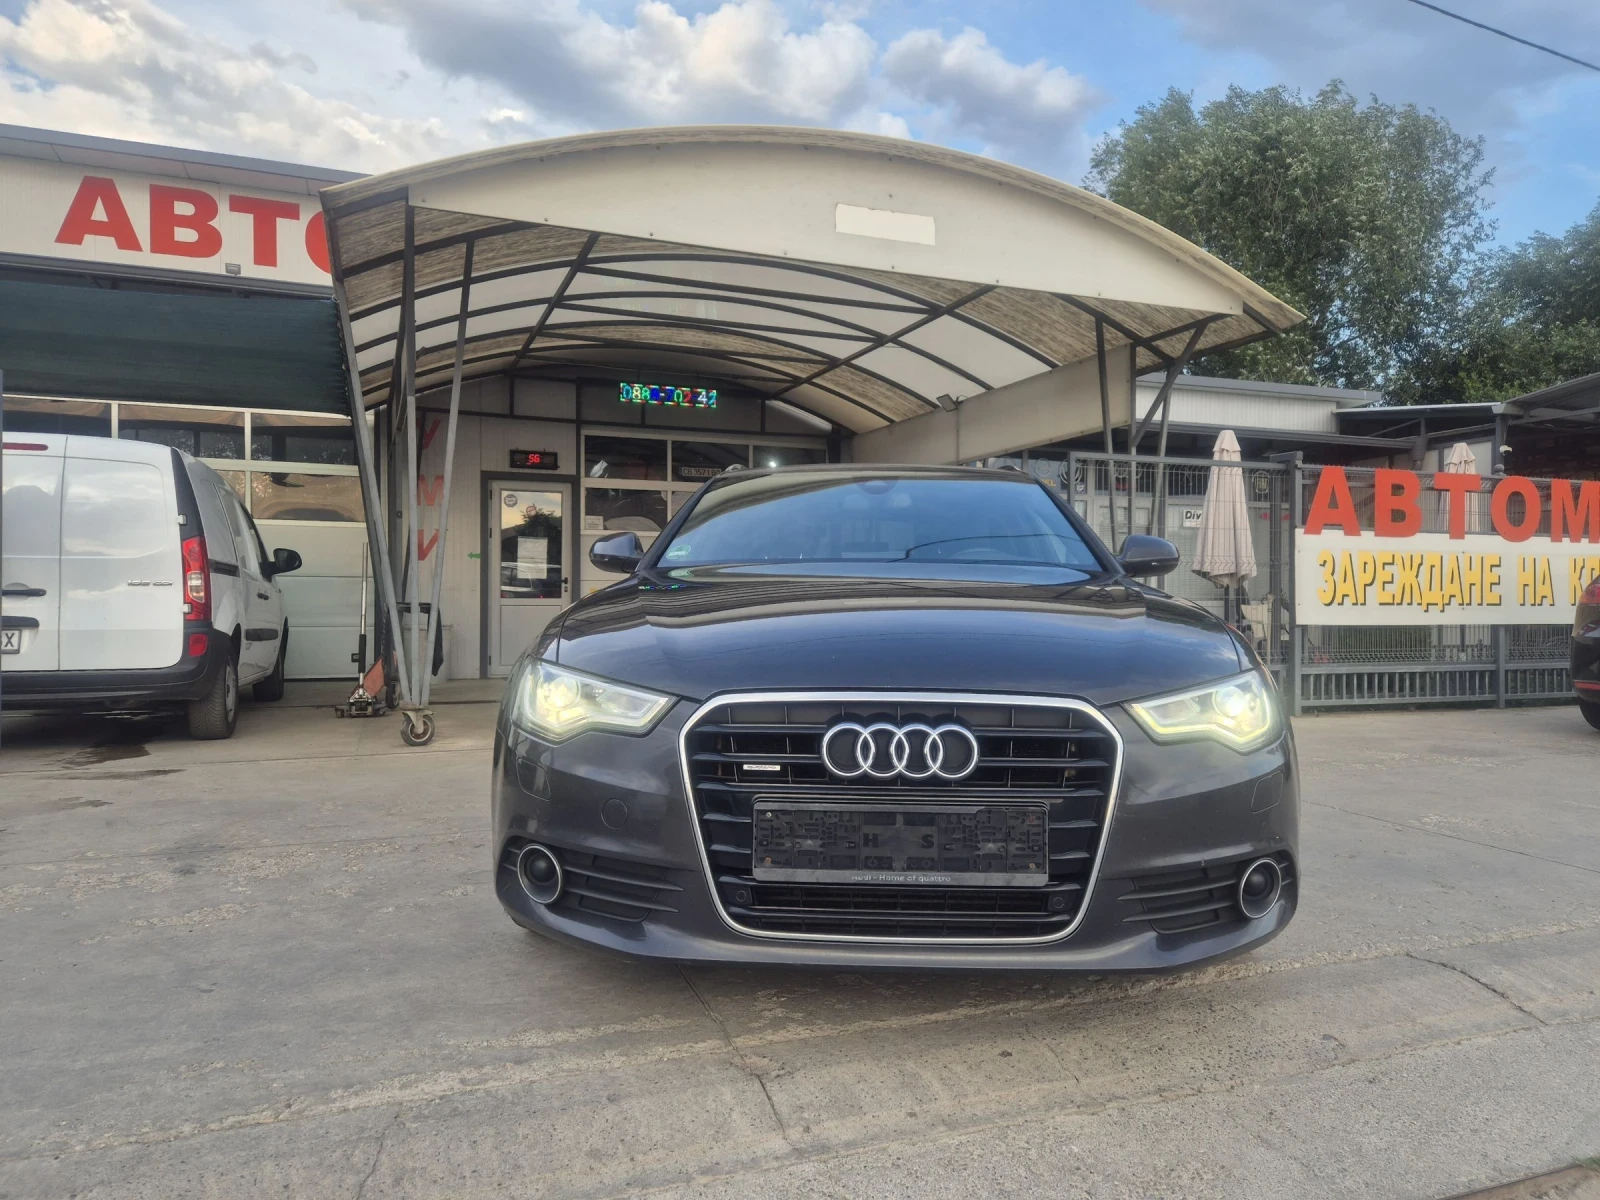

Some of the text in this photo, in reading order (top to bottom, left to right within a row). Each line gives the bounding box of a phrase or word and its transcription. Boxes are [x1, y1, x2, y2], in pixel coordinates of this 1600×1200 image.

[1317, 548, 1502, 613] ЗАРЕЖДАНЕ
[1518, 553, 1555, 606] НА
[918, 875, 951, 883] quattro
